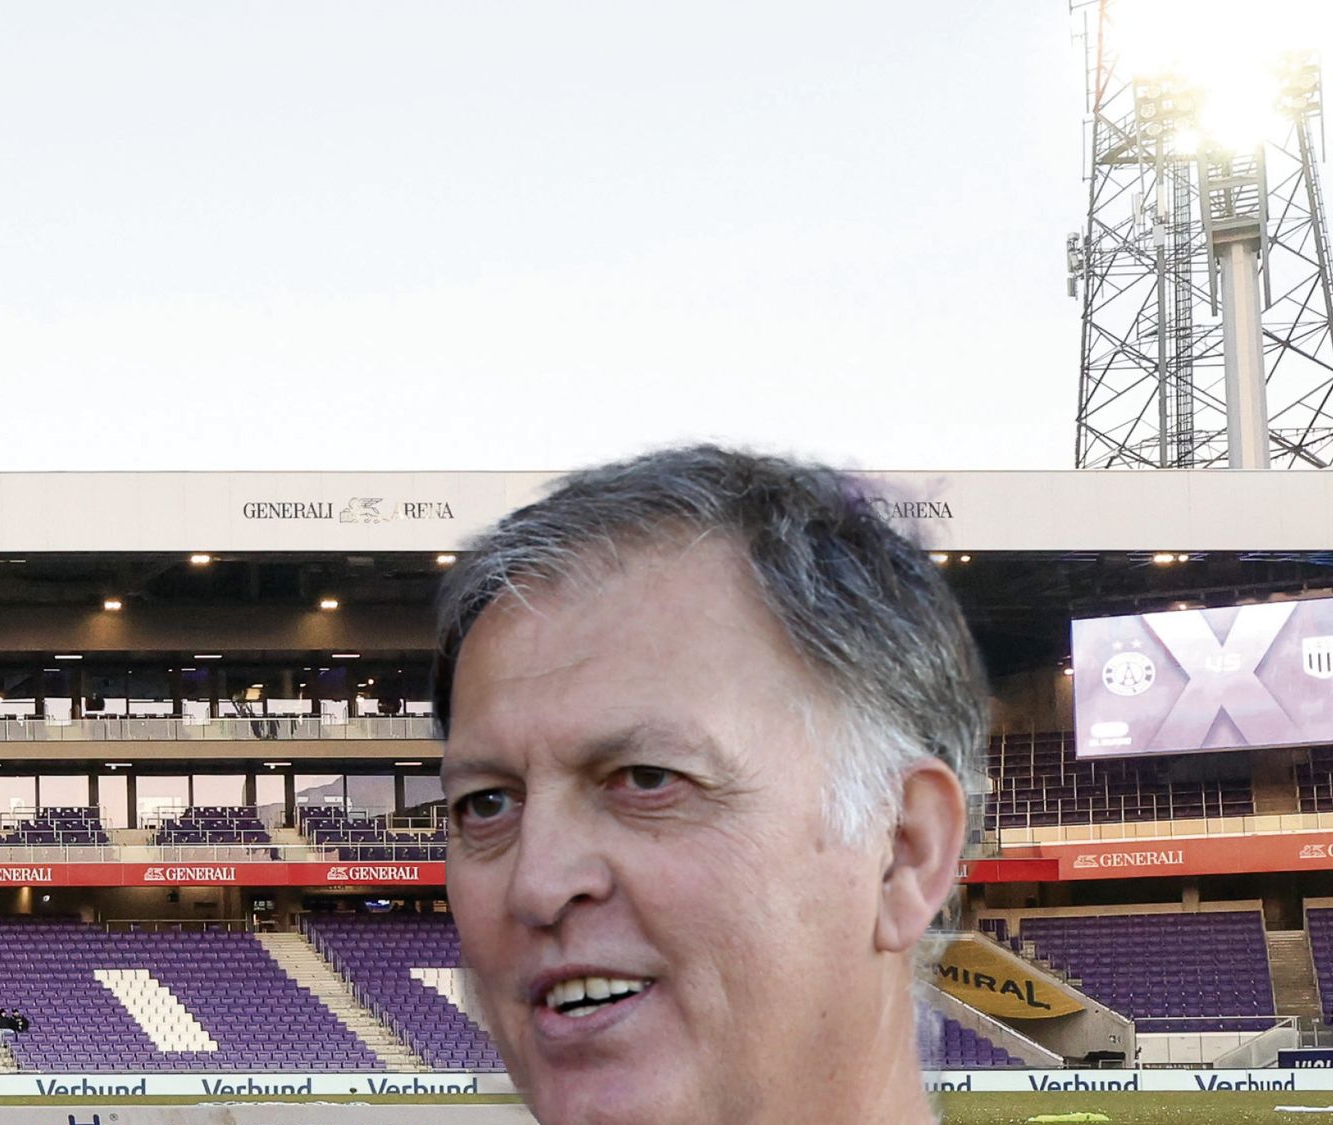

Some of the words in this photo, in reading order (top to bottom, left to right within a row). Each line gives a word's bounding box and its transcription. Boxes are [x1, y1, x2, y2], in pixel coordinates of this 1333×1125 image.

[243, 502, 333, 519] GENERALI
[891, 501, 954, 519] ARENA
[1100, 850, 1184, 867] GENERALI
[165, 867, 236, 881] GENERALI
[349, 867, 419, 880] GENERALI
[933, 963, 1052, 1011] MIRAL
[36, 1078, 145, 1095] Verbund
[202, 1078, 311, 1094] Verbund
[367, 1077, 477, 1093] Verbund
[1029, 1074, 1138, 1090] Verbund
[1195, 1073, 1294, 1090] Verbund
